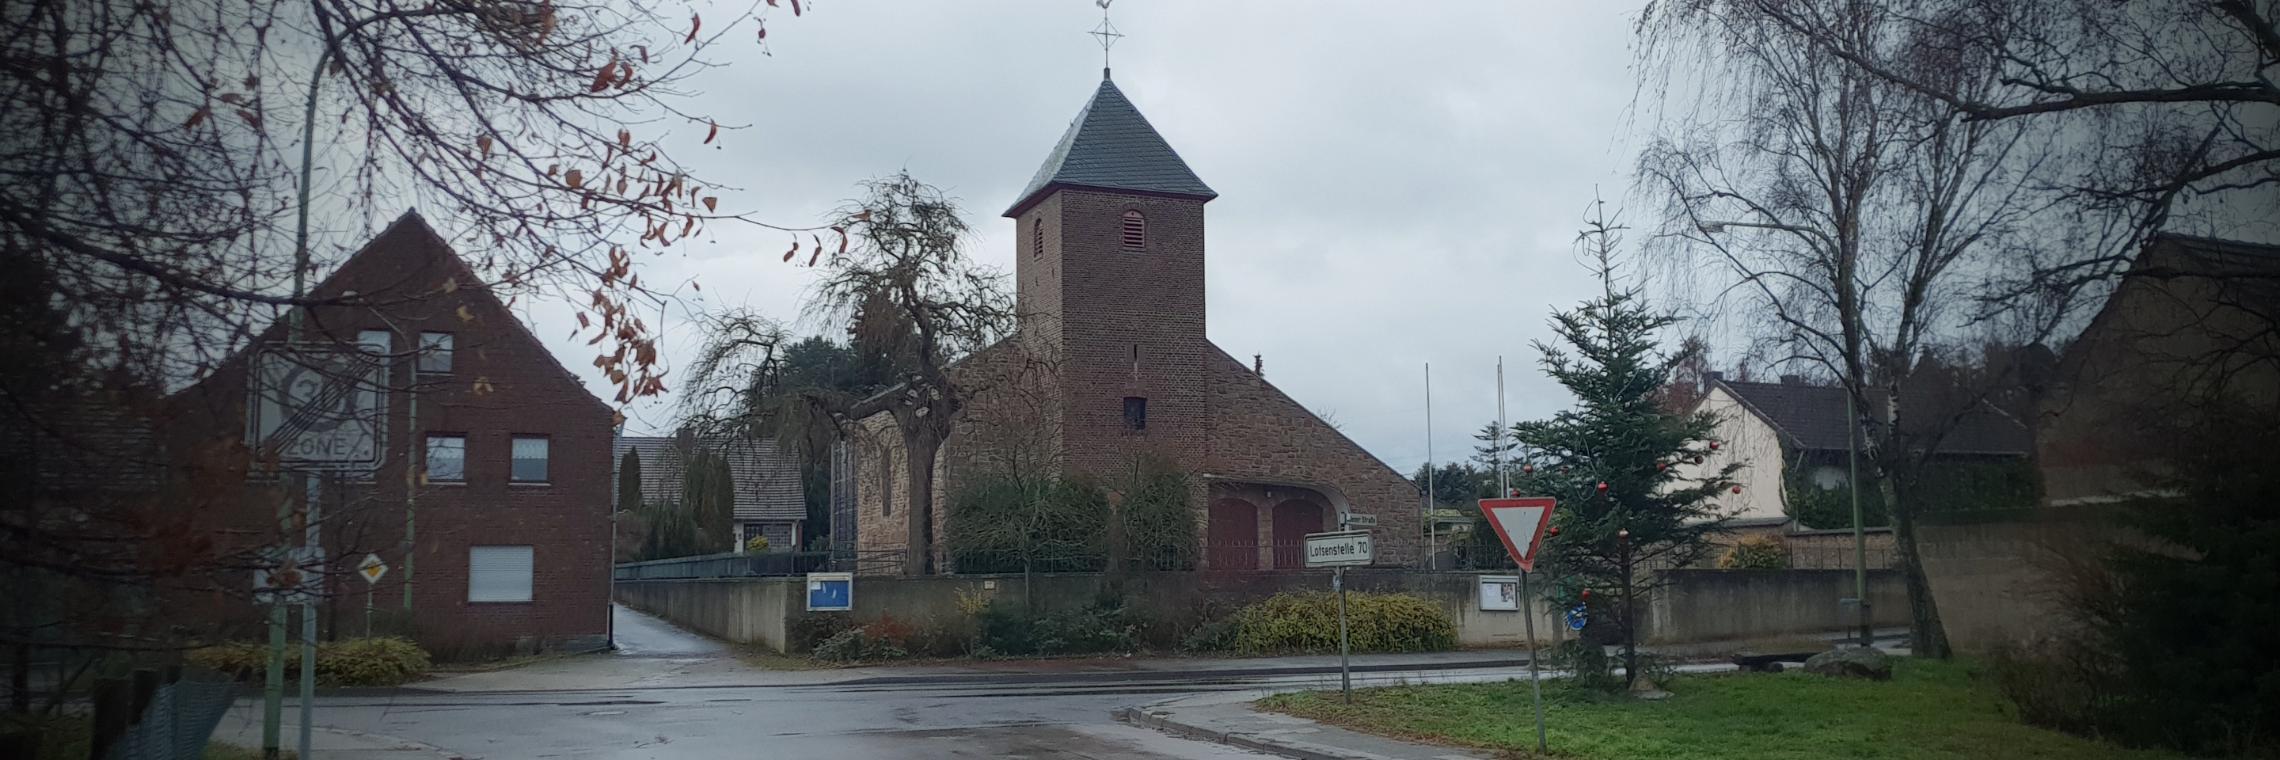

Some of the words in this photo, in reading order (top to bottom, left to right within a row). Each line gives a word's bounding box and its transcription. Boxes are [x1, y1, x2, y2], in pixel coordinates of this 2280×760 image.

[287, 434, 347, 455] ZONE
[1310, 543, 1355, 557] Lotsenstelle
[1358, 541, 1368, 554] 70
